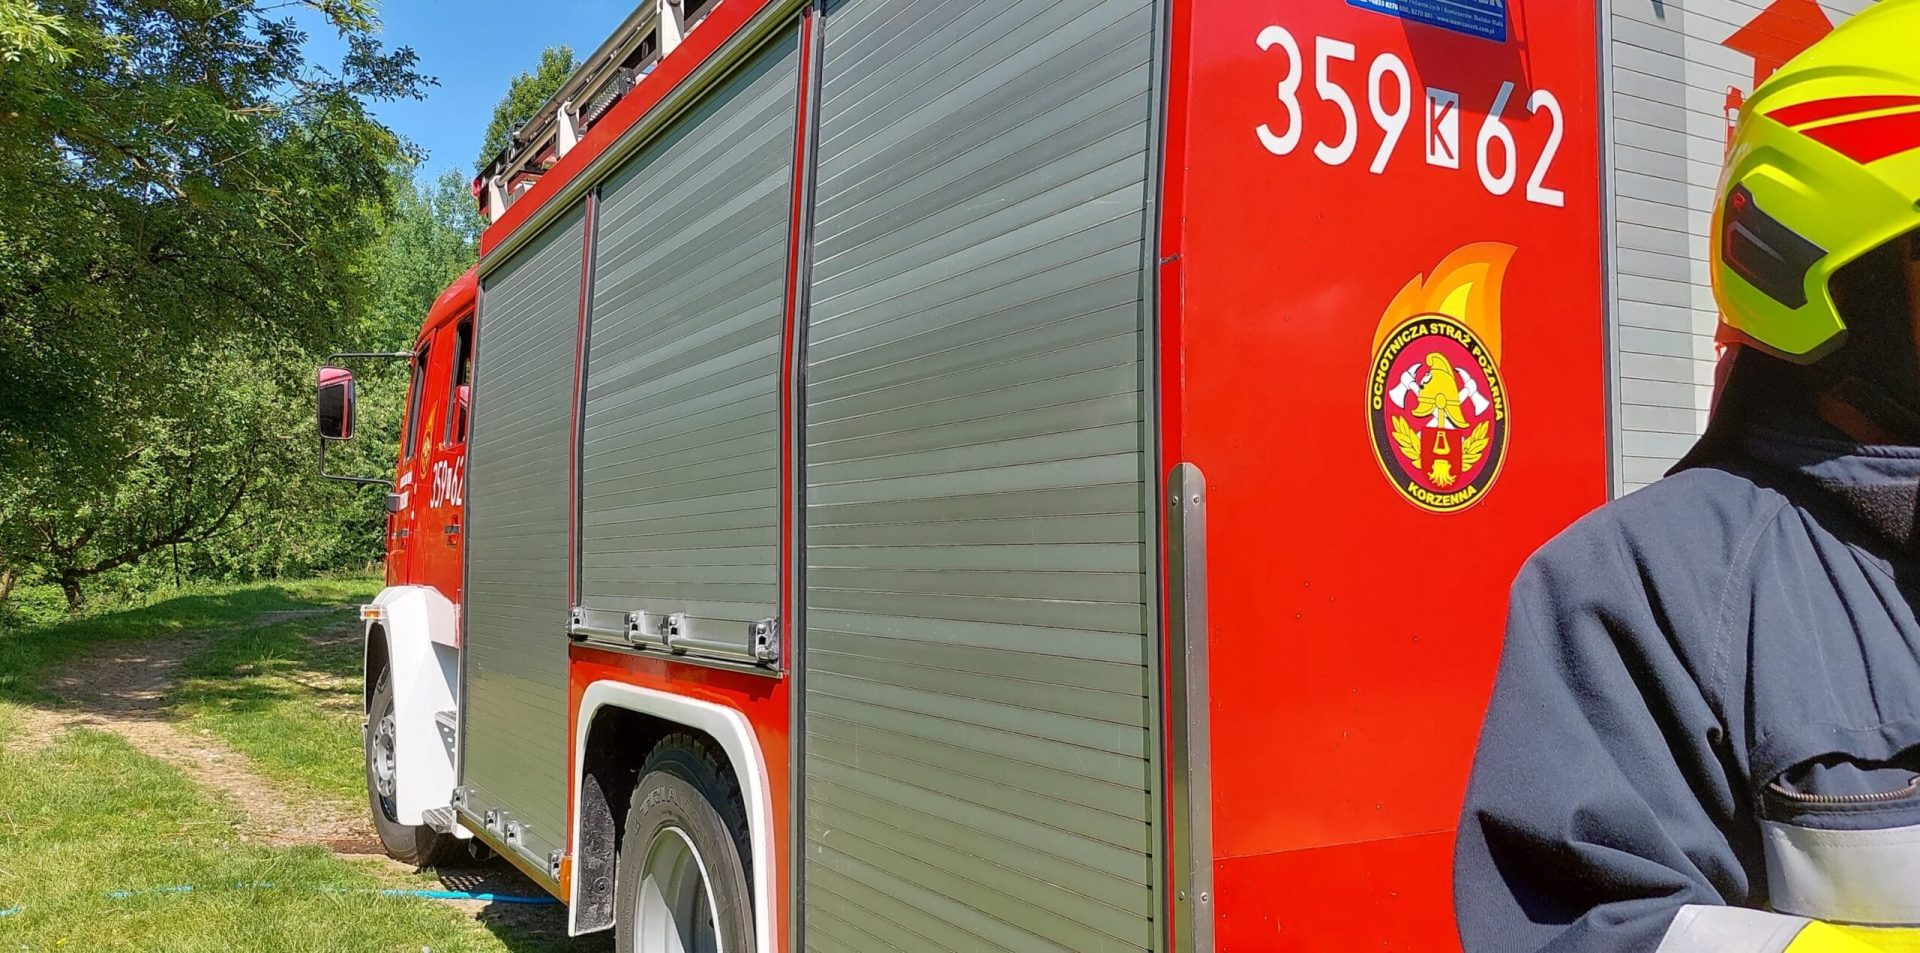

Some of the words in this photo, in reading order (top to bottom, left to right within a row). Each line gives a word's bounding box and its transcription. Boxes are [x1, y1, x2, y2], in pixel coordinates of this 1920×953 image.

[1373, 324, 1428, 410] OCHOTNICZA
[1430, 322, 1473, 348] STRAŻ
[1472, 347, 1504, 421] POŻARNA
[1408, 481, 1477, 507] KORZENNA
